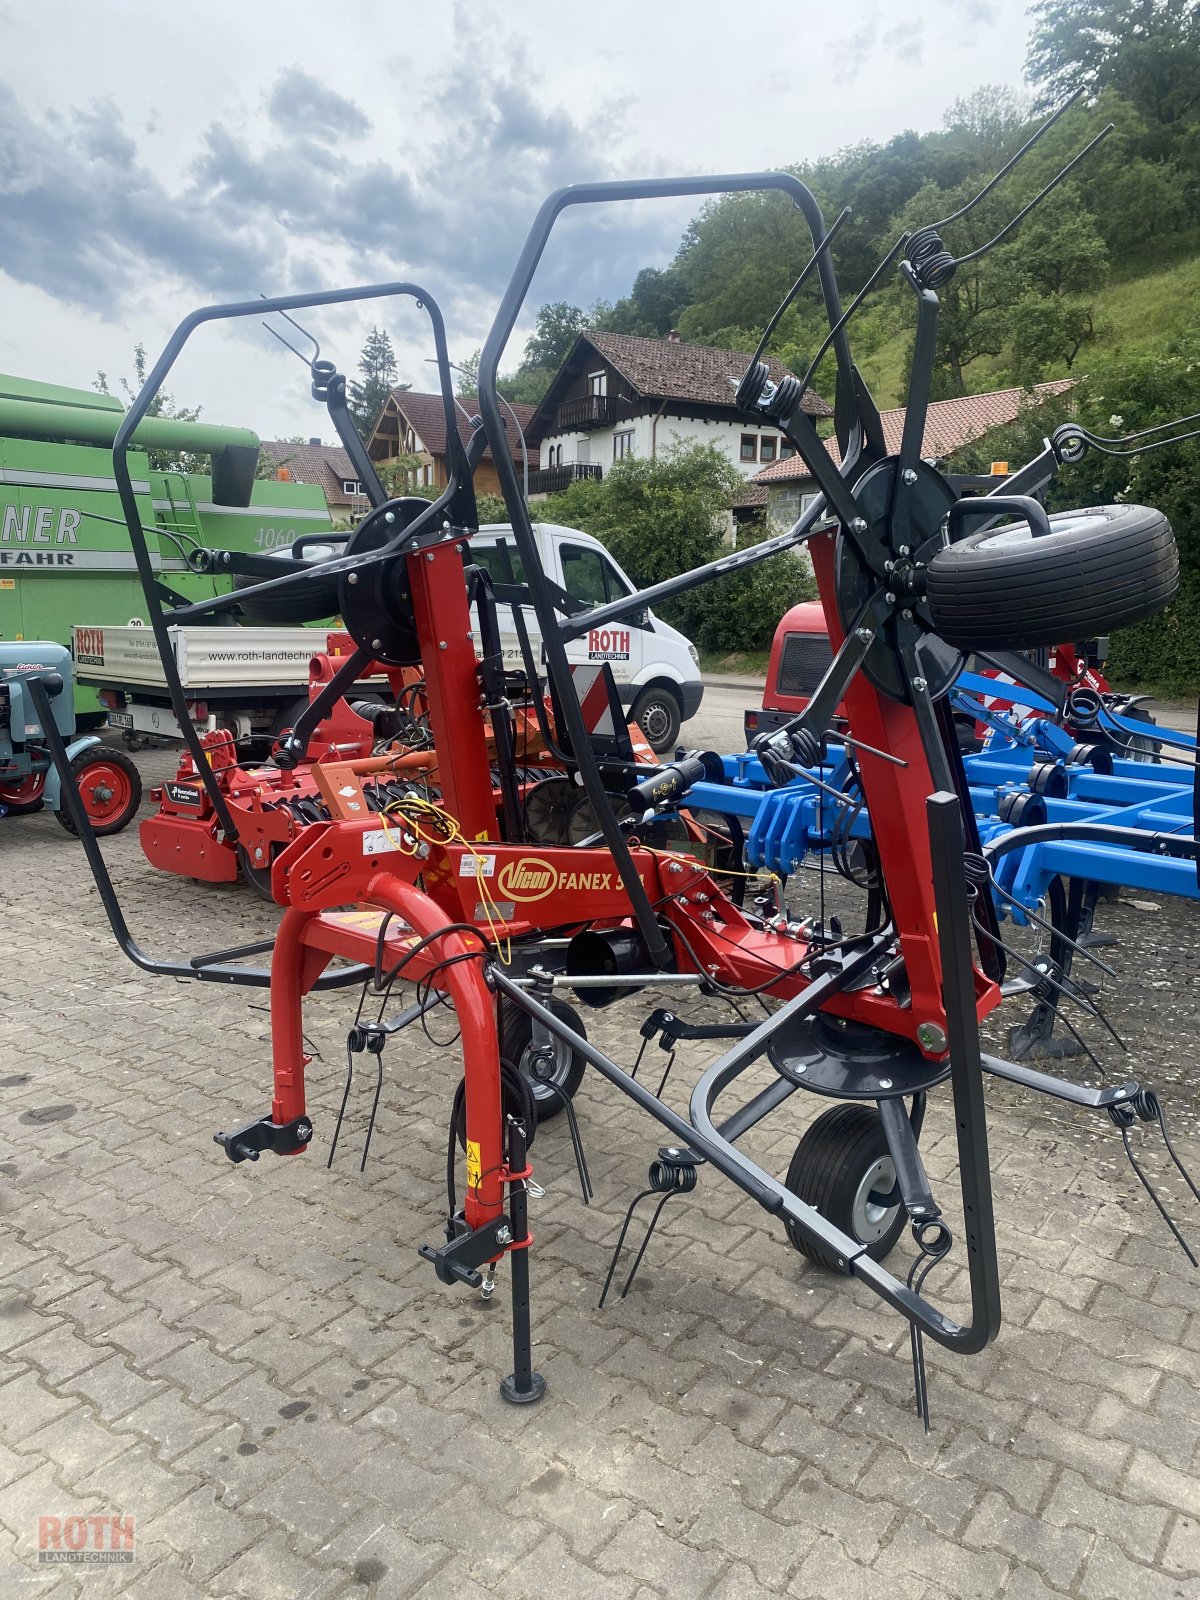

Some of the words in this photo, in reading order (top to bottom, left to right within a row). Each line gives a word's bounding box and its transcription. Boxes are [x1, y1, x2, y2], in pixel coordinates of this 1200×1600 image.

[1, 504, 82, 544] NER
[0, 552, 75, 565] FAHR
[76, 629, 104, 655] ROTH
[588, 630, 630, 652] ROTH
[208, 651, 317, 661] www.roth-landtechni
[591, 652, 628, 660] LANDTECHNIK
[503, 860, 554, 893] Vicon
[558, 872, 612, 890] FANEX
